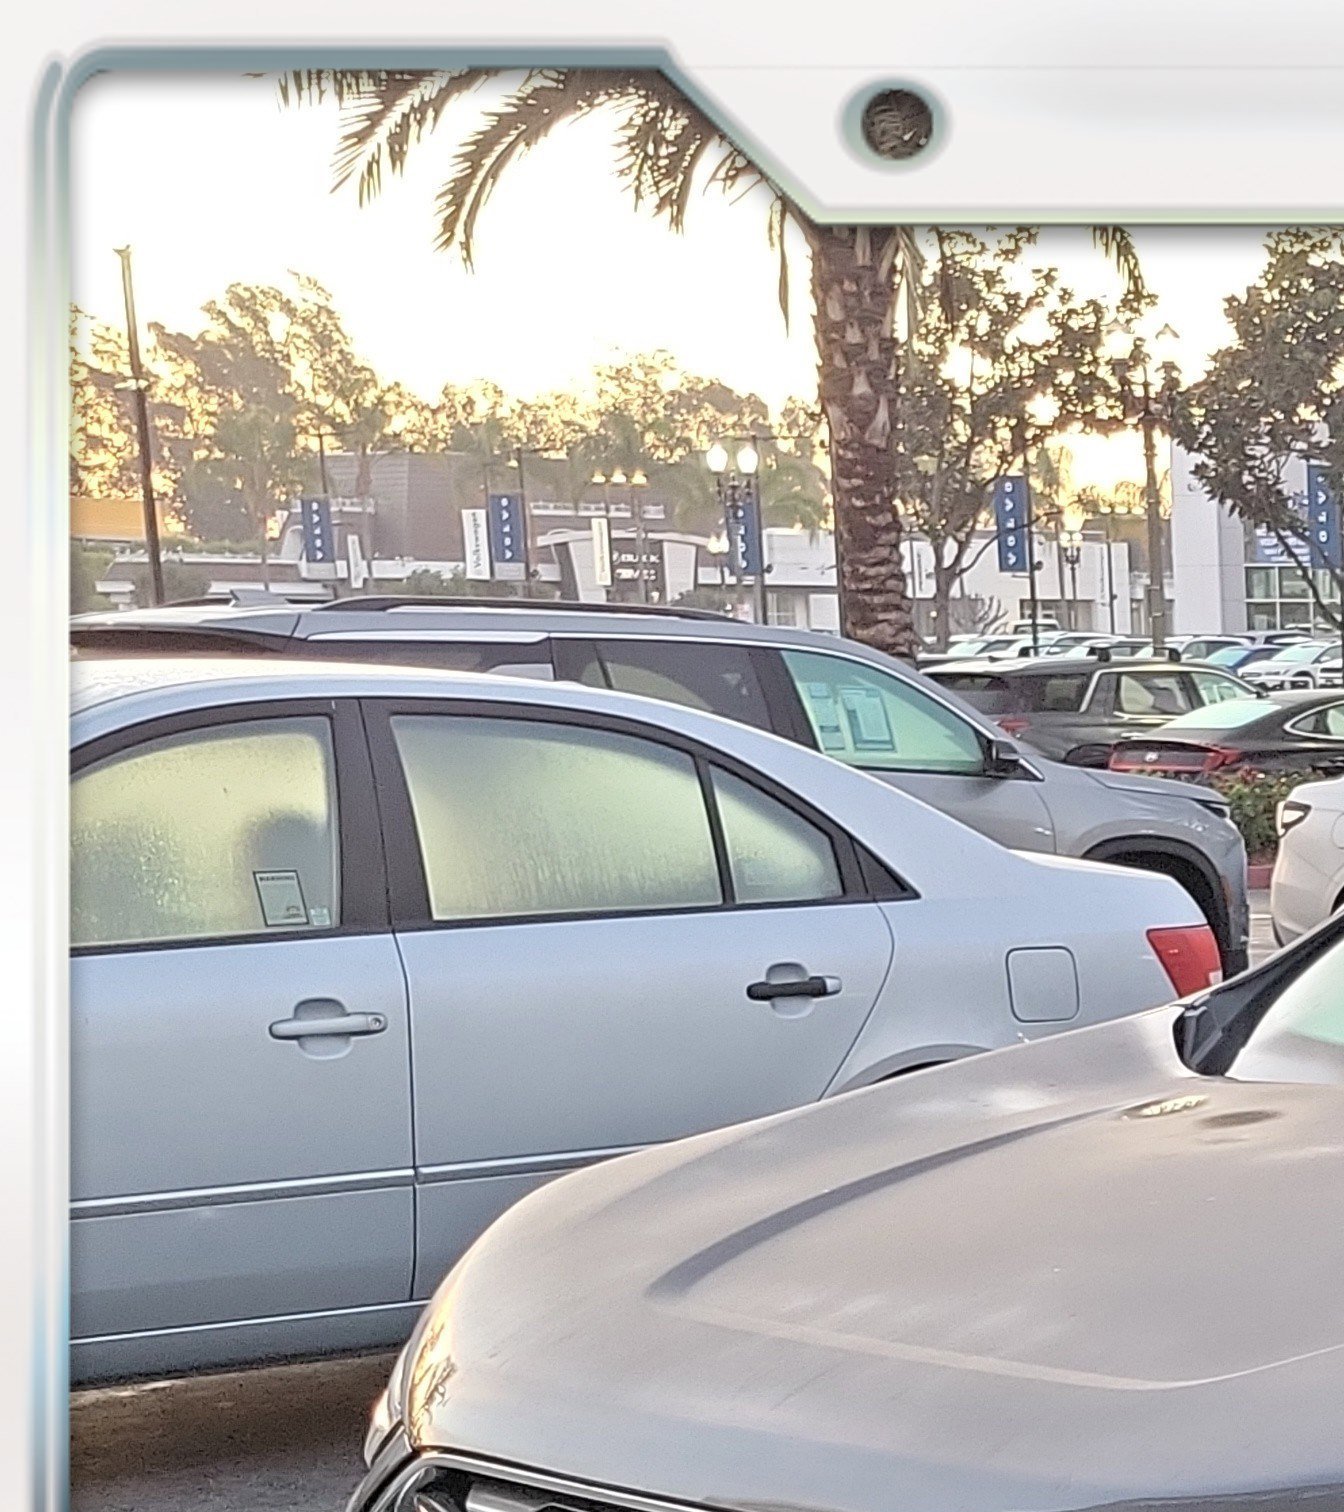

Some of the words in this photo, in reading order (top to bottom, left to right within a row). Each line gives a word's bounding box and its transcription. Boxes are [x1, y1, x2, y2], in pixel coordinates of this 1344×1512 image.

[311, 501, 324, 560] VOLVO
[499, 497, 513, 560] VOLVO
[1004, 482, 1017, 565] VOLVO
